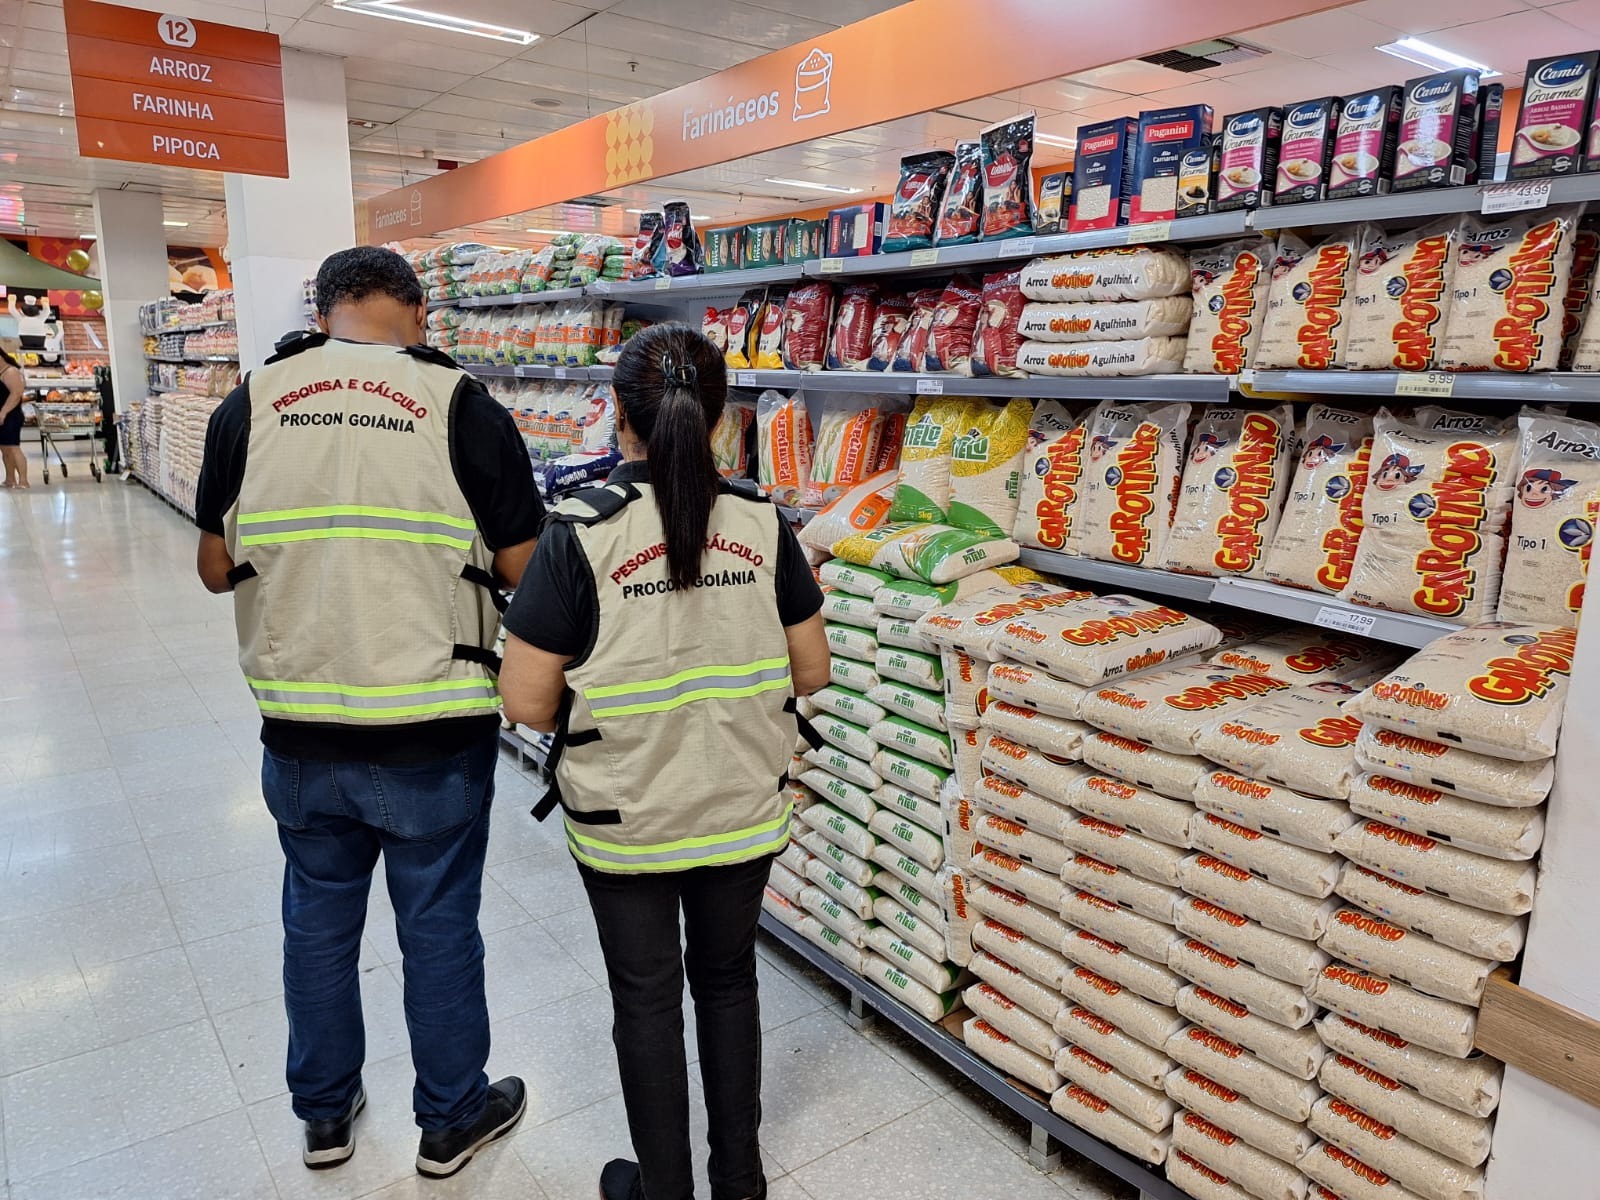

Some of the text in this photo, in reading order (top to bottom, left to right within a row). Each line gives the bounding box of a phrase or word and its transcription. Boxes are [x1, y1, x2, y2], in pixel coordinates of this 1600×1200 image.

[165, 20, 189, 43] 12
[149, 56, 213, 83] ARROZ
[1539, 63, 1584, 82] Camil
[1415, 81, 1451, 98] Camil
[1528, 85, 1584, 104] Gourmet
[132, 93, 214, 120] FARINHA
[681, 88, 780, 142] Farináceos
[1292, 107, 1321, 124] Camil
[1148, 124, 1188, 138] Paganini
[1230, 117, 1260, 133] Camil
[1339, 119, 1381, 135] Gourmet
[152, 135, 221, 160] PIPOCA
[1084, 136, 1115, 151] Paganini
[1185, 153, 1208, 166] Camil
[1517, 185, 1549, 197] 43,99
[374, 207, 407, 229] Farináceos
[1468, 228, 1513, 241] Arroz
[1026, 277, 1048, 288] Arroz
[1051, 271, 1096, 289] GAROTINHO
[1355, 294, 1376, 306] Tipo 1
[1454, 288, 1477, 299] Tipo 1
[1296, 243, 1352, 371] GAROTINHO
[1024, 316, 1137, 334] Arroz GAROTINHO Agulhinha
[1023, 352, 1136, 368] Arroz GAROTINHO Agulhinha
[1428, 374, 1454, 384] 9,99
[272, 378, 428, 419] PESQUISA E CÁLCULO
[280, 412, 415, 433] PROCON GOIÂNIA
[1041, 412, 1071, 430] Arroz
[1316, 408, 1361, 425] Arroz
[1433, 414, 1485, 430] Arroz
[1537, 431, 1599, 459] Arroz
[1202, 483, 1206, 492] 1
[1214, 412, 1280, 573] GAROTINHO
[1293, 491, 1316, 501] Tipo 1
[1372, 513, 1398, 526] Tipo 1
[1413, 441, 1496, 617] GAROTINHO
[1517, 535, 1546, 550] Tipo 1
[610, 542, 668, 585] PESQUIS
[694, 569, 757, 588] GOIÂNIA
[1060, 605, 1191, 647] GAROTINHO
[1349, 614, 1373, 627] 17,99
[1102, 666, 1123, 679] Arroz
[1125, 650, 1166, 673] GAROTINHO
[1220, 652, 1274, 674] GAROTINHO
[1373, 681, 1451, 711] GAROTINHO
[1221, 722, 1281, 746] GAROTINHO
[1211, 772, 1272, 800] GAROTINHO
[1335, 909, 1406, 942] GAROTINHO
[1322, 965, 1391, 996] GAROTINHO
